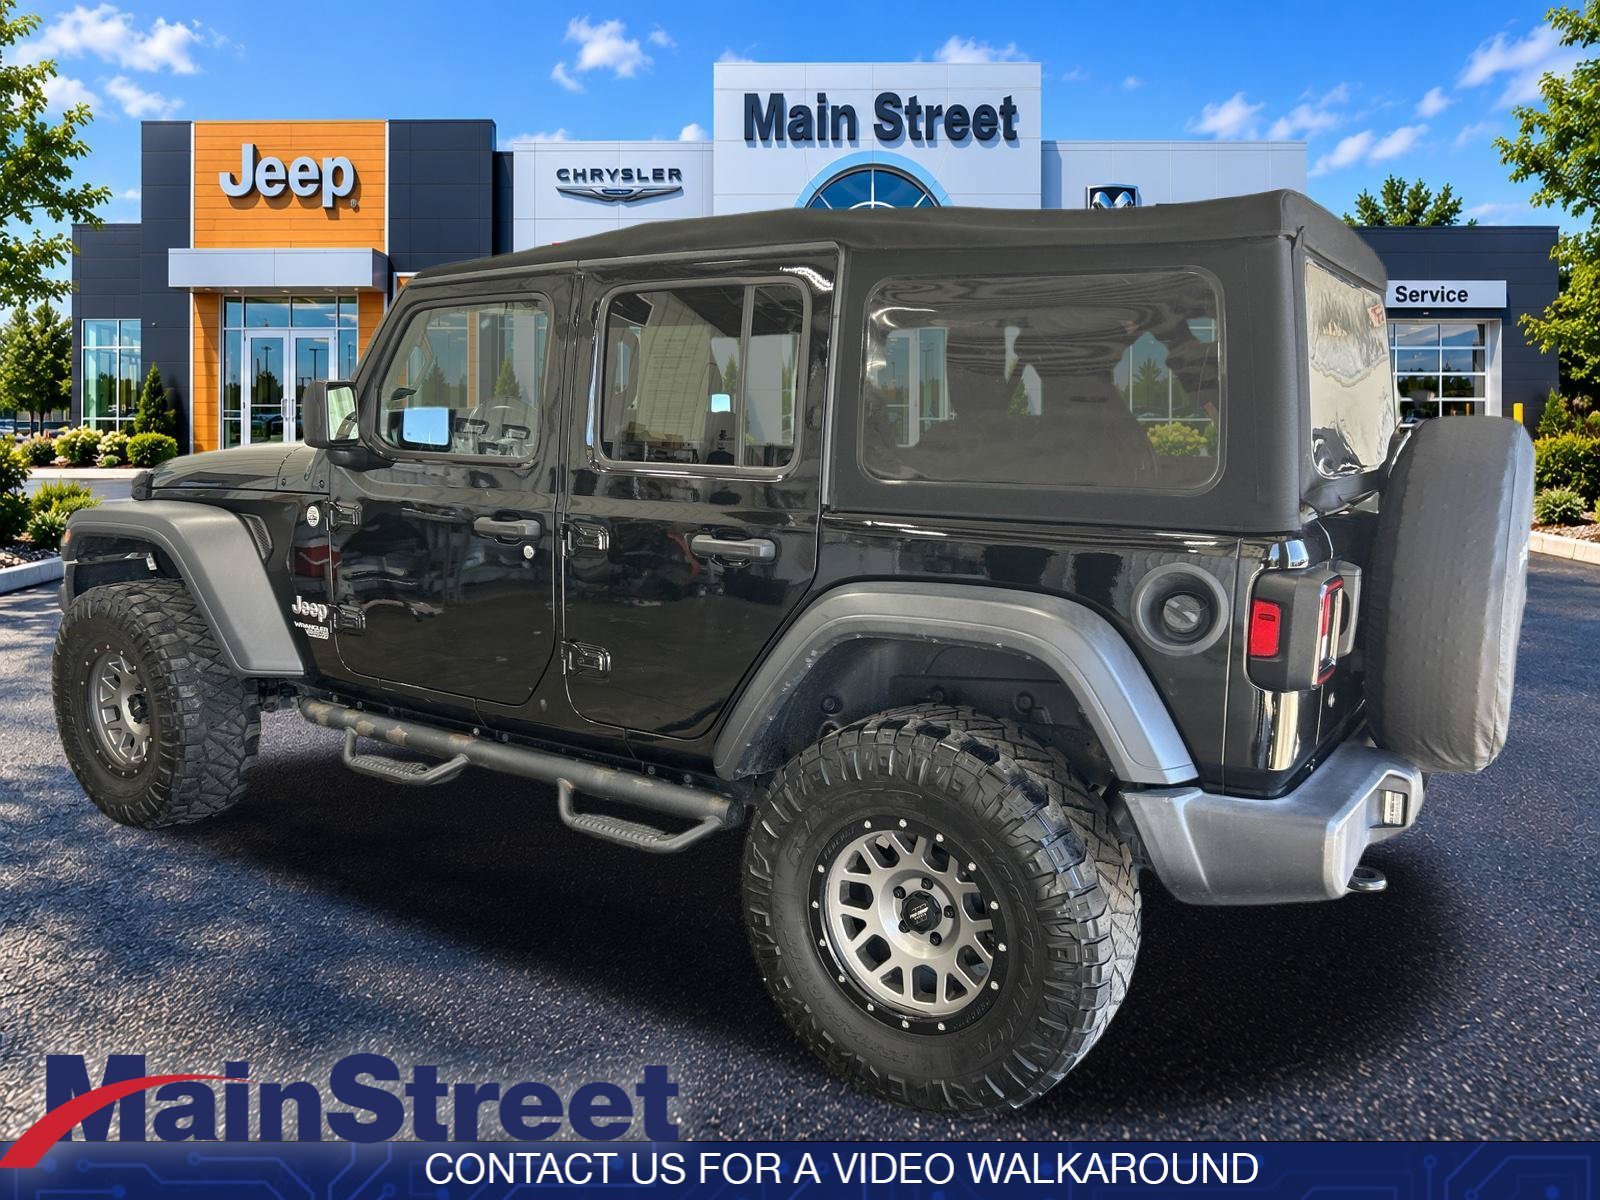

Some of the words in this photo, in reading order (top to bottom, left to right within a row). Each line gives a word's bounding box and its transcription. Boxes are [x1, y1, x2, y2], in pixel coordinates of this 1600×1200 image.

[743, 92, 856, 141] Main
[873, 91, 1018, 141] Street
[219, 143, 354, 208] Jeep
[556, 168, 682, 182] CHRYSLER
[1395, 285, 1468, 303] Service
[292, 595, 328, 622] Jeep
